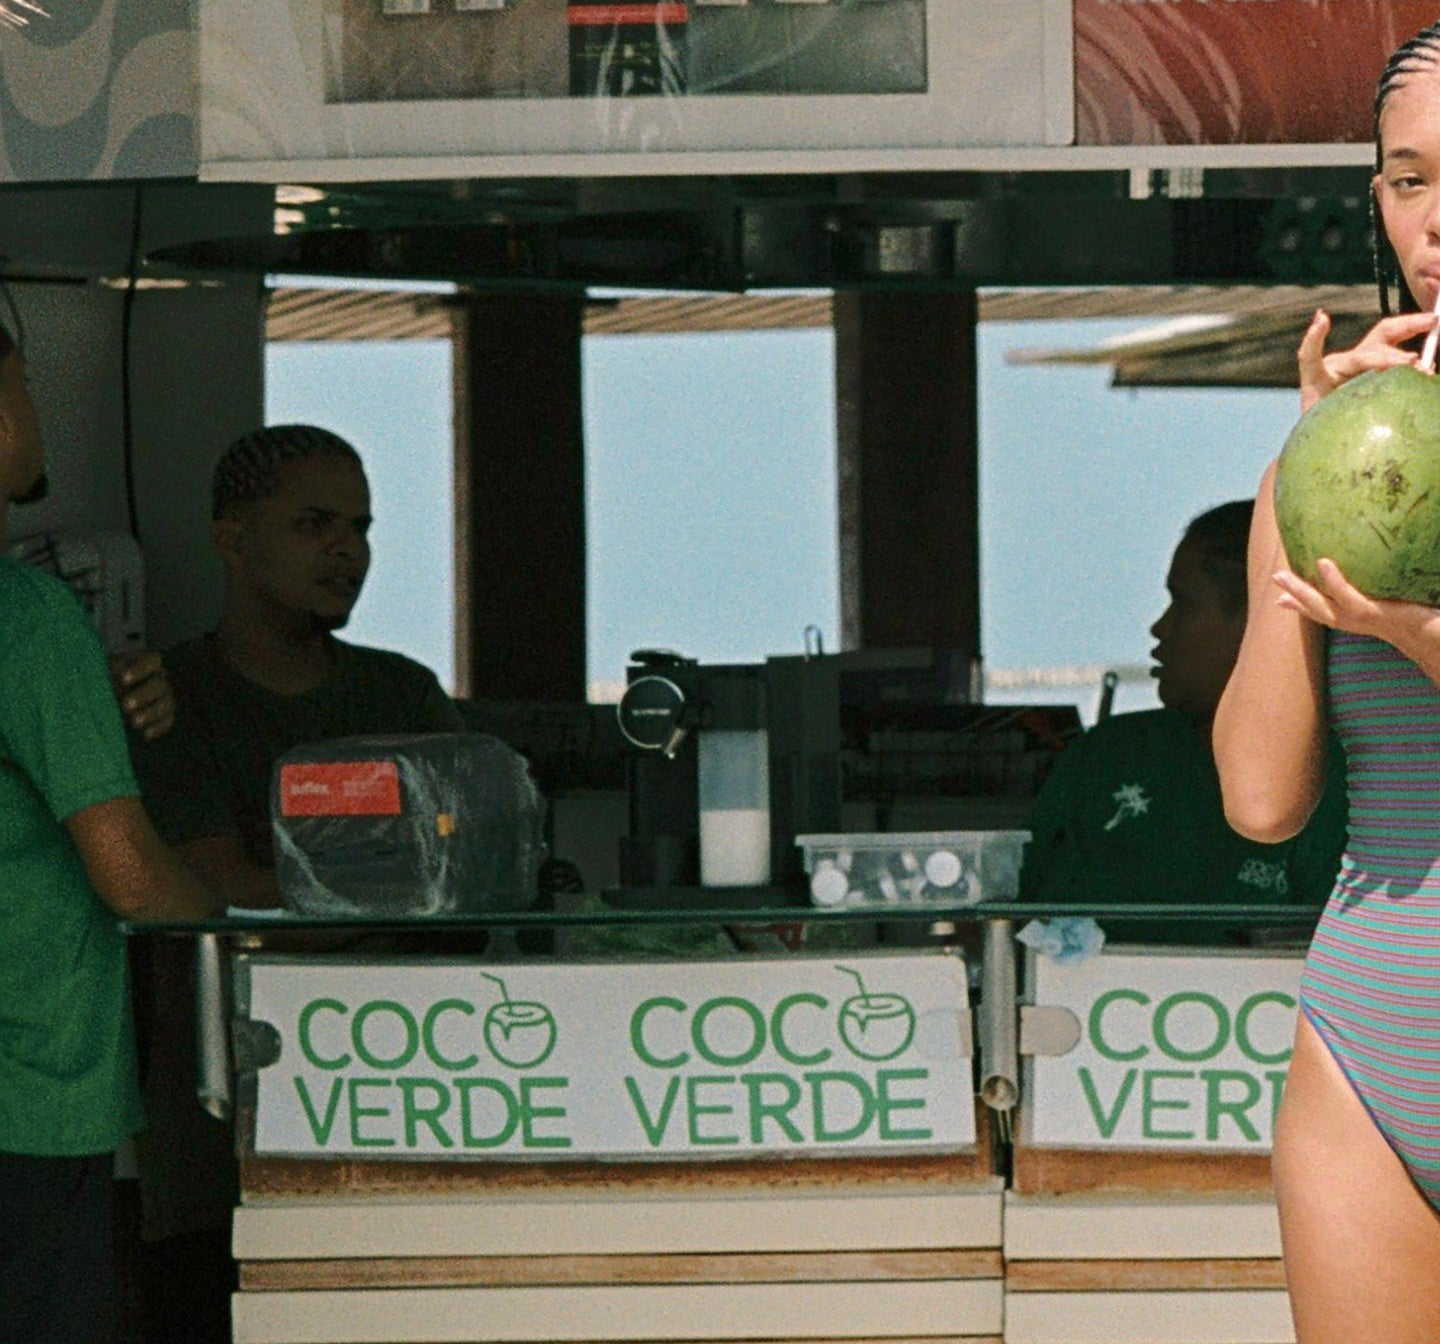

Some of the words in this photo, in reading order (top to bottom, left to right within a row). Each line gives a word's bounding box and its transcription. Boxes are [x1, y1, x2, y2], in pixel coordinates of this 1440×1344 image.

[294, 1076, 572, 1148] VERDE
[625, 1068, 933, 1146] VERDE
[1077, 1067, 1289, 1141] VER
